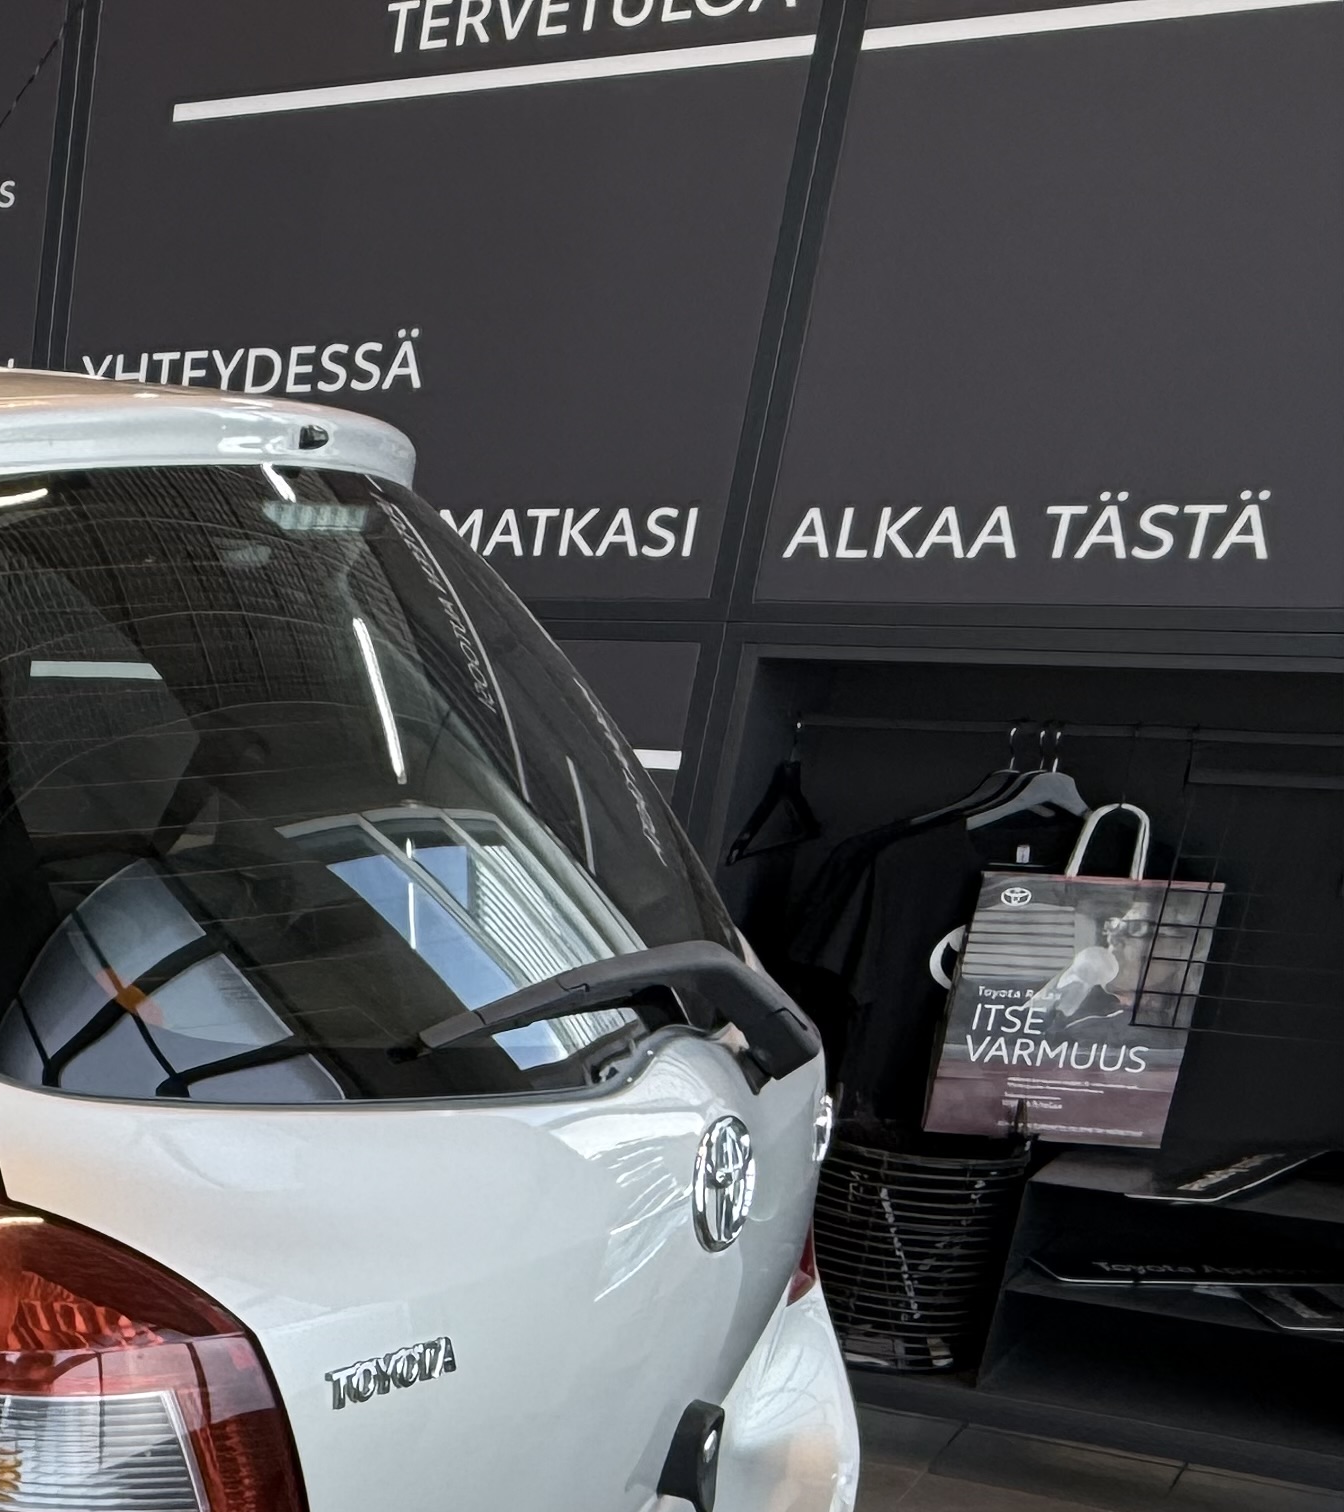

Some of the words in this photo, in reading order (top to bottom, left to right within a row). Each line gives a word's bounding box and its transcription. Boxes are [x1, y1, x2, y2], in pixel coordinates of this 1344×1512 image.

[782, 505, 1016, 559] ALKAA
[1046, 489, 1271, 560] TÄSTÄ
[972, 1003, 1047, 1034] ITSE
[966, 1034, 1149, 1073] VARMUUS
[325, 1336, 457, 1410] TOYOTA
